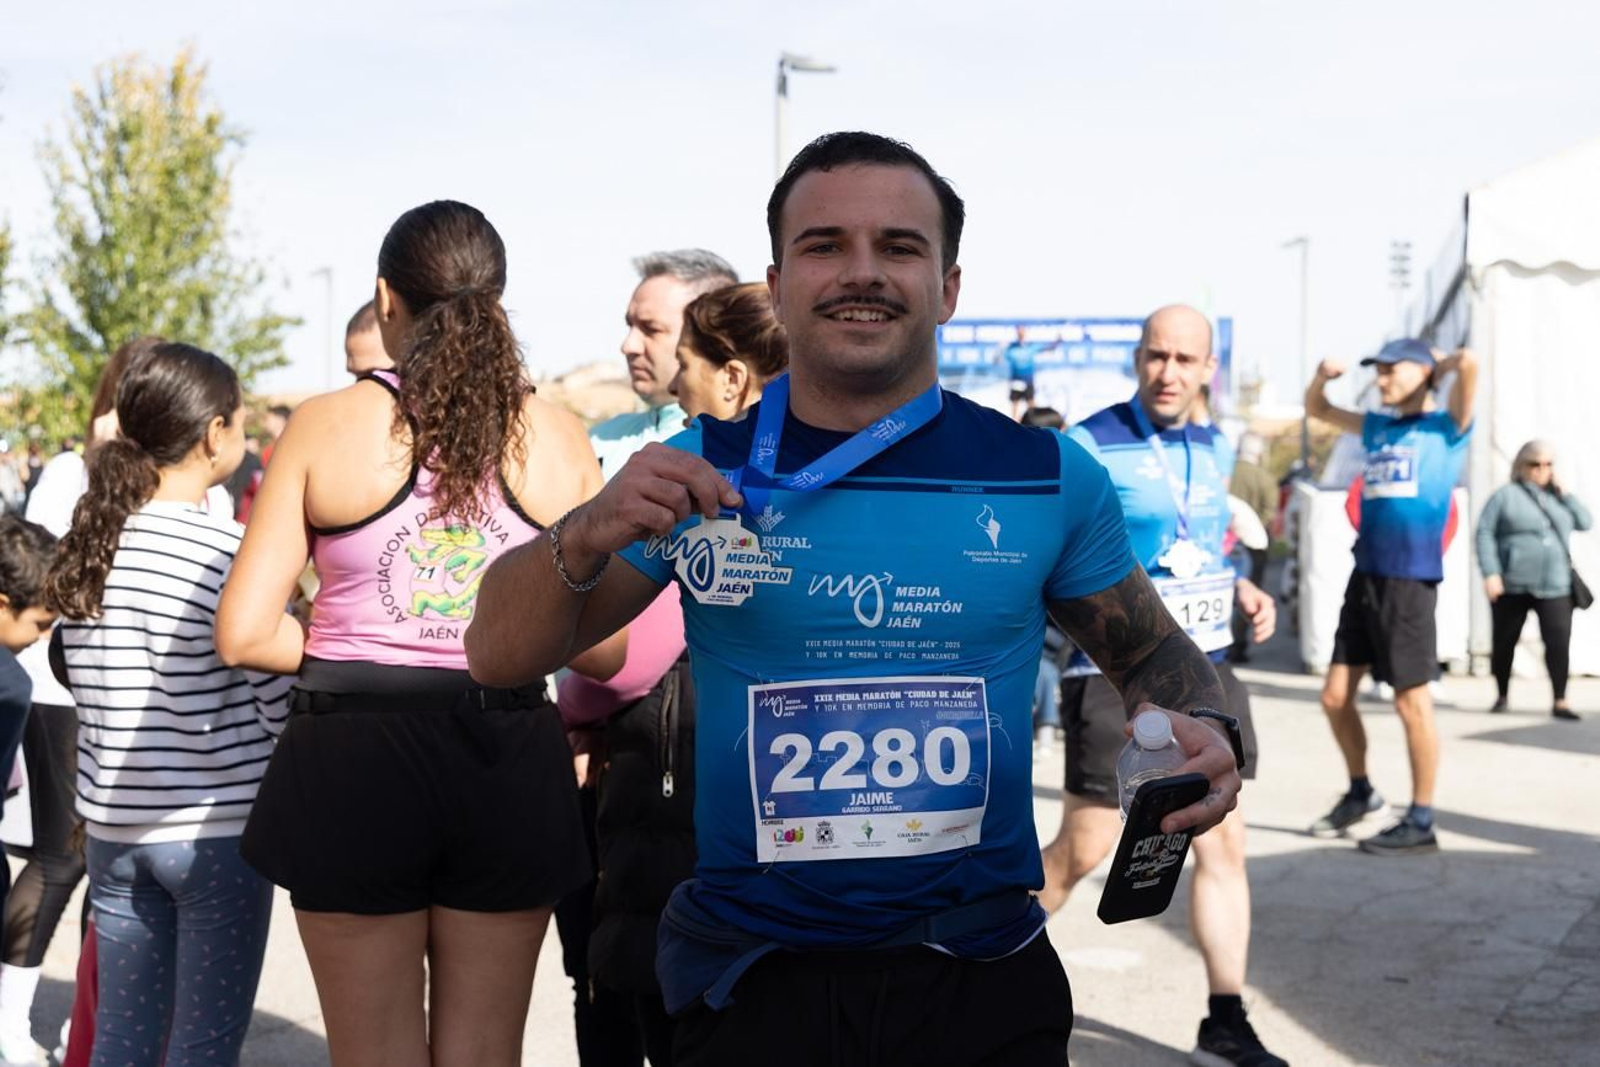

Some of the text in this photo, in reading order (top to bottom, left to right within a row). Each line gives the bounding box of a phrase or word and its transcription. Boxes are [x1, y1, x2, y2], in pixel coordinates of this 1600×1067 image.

[762, 536, 812, 549] RURAL
[725, 552, 770, 565] MEDIA
[377, 525, 412, 624] ASOCIACION
[721, 567, 789, 582] MARATÓN
[716, 582, 751, 594] JAÉN
[895, 586, 941, 597] MEDIA
[892, 600, 963, 613] MARATÓN
[886, 616, 922, 628] JAÉN
[418, 626, 459, 640] JAÉN
[845, 639, 876, 648] MARATÓN
[814, 694, 833, 702] XXIX
[835, 692, 860, 701] MEDIA
[862, 690, 901, 700] MARATÓN
[814, 700, 978, 712] Y 10K EN MEMORIA DE PACO MANZANEDA
[769, 726, 971, 793] 2280
[849, 792, 894, 806] JAIME
[842, 805, 902, 814] GARRIDO SERRANO
